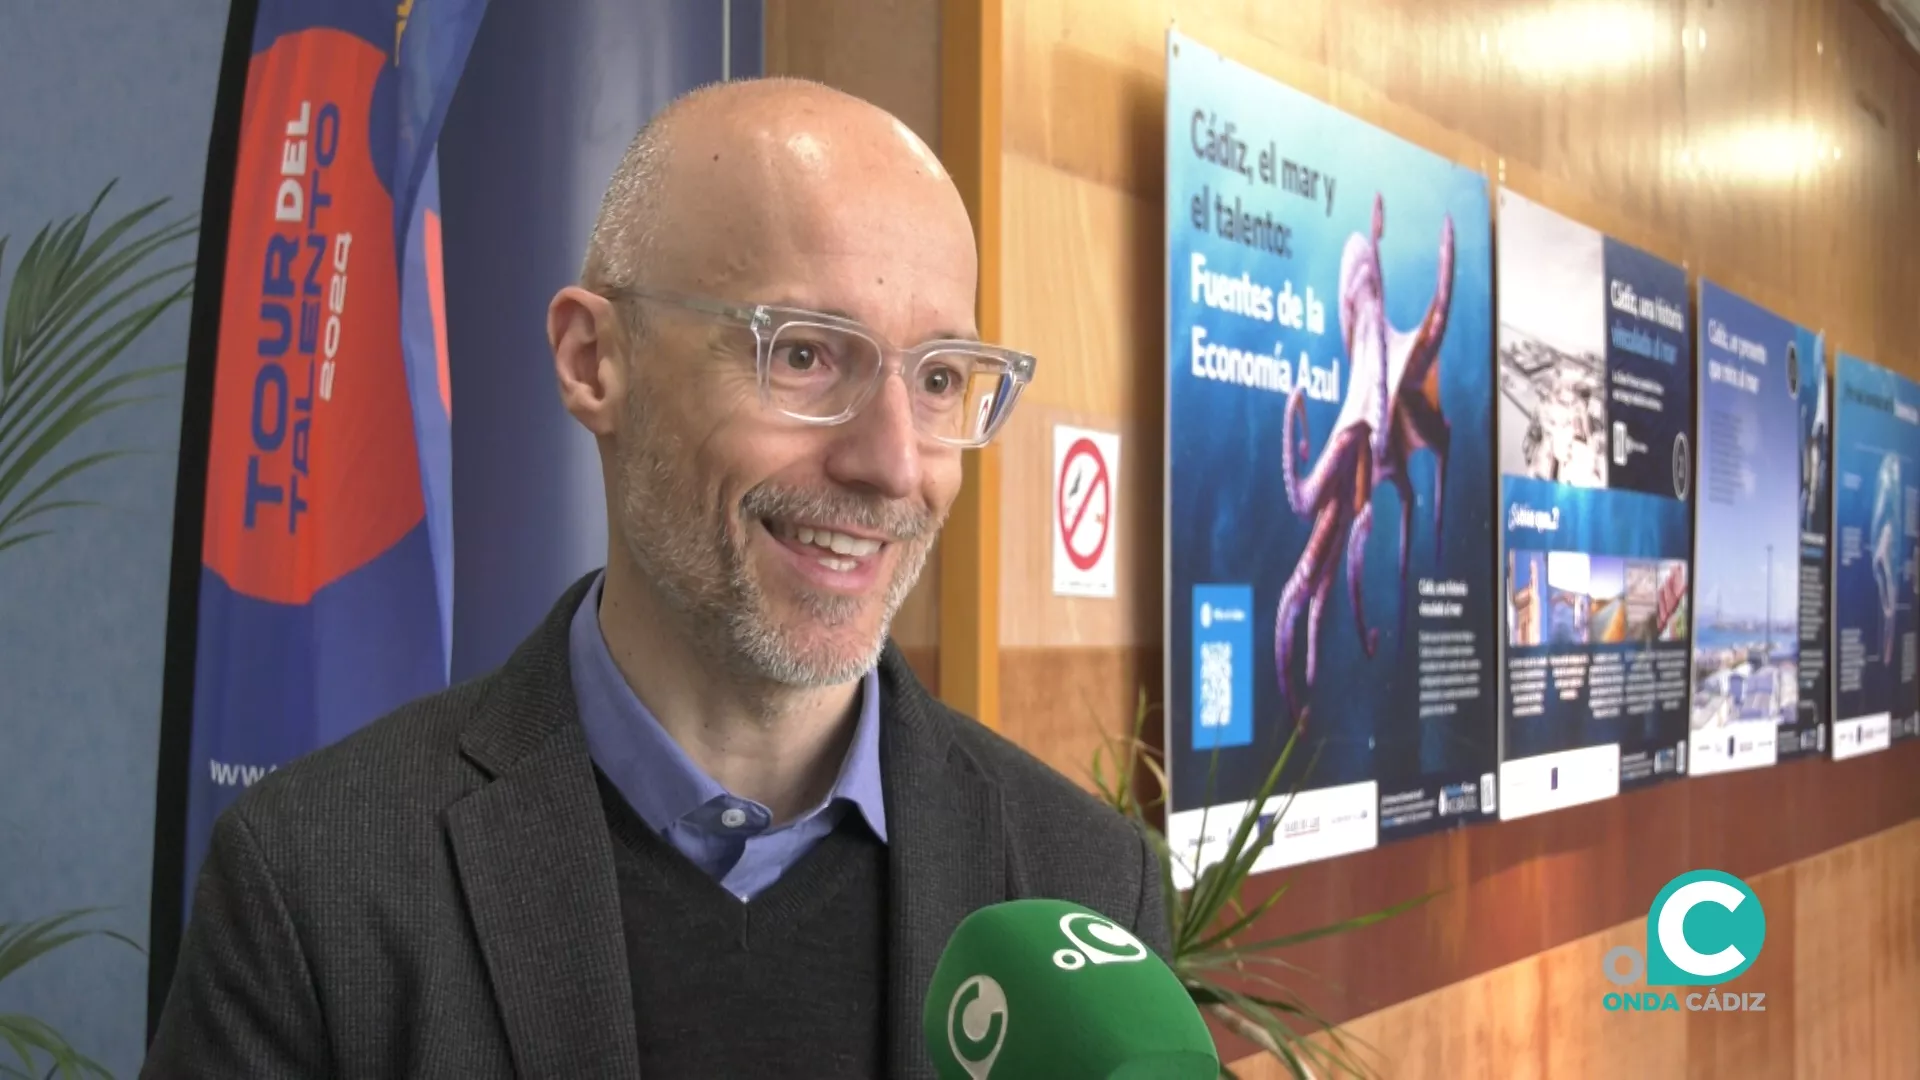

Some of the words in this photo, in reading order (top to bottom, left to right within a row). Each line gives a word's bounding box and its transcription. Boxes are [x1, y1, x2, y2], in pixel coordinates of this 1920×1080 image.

[1190, 108, 1254, 185] Cádiz,
[1258, 138, 1277, 188] el
[1281, 157, 1321, 202] mar
[1322, 172, 1337, 219] y
[1190, 184, 1210, 234] el
[1214, 191, 1294, 261] talento:
[243, 233, 299, 530] TOUR
[275, 101, 311, 223] DEL
[289, 102, 341, 535] TALENTO
[319, 231, 353, 402] 2024
[1190, 251, 1275, 323] Fuentes
[1276, 279, 1305, 331] de
[1305, 285, 1326, 336] la
[1190, 325, 1294, 396] Economía
[1295, 350, 1340, 405] Azul
[209, 757, 278, 788] www
